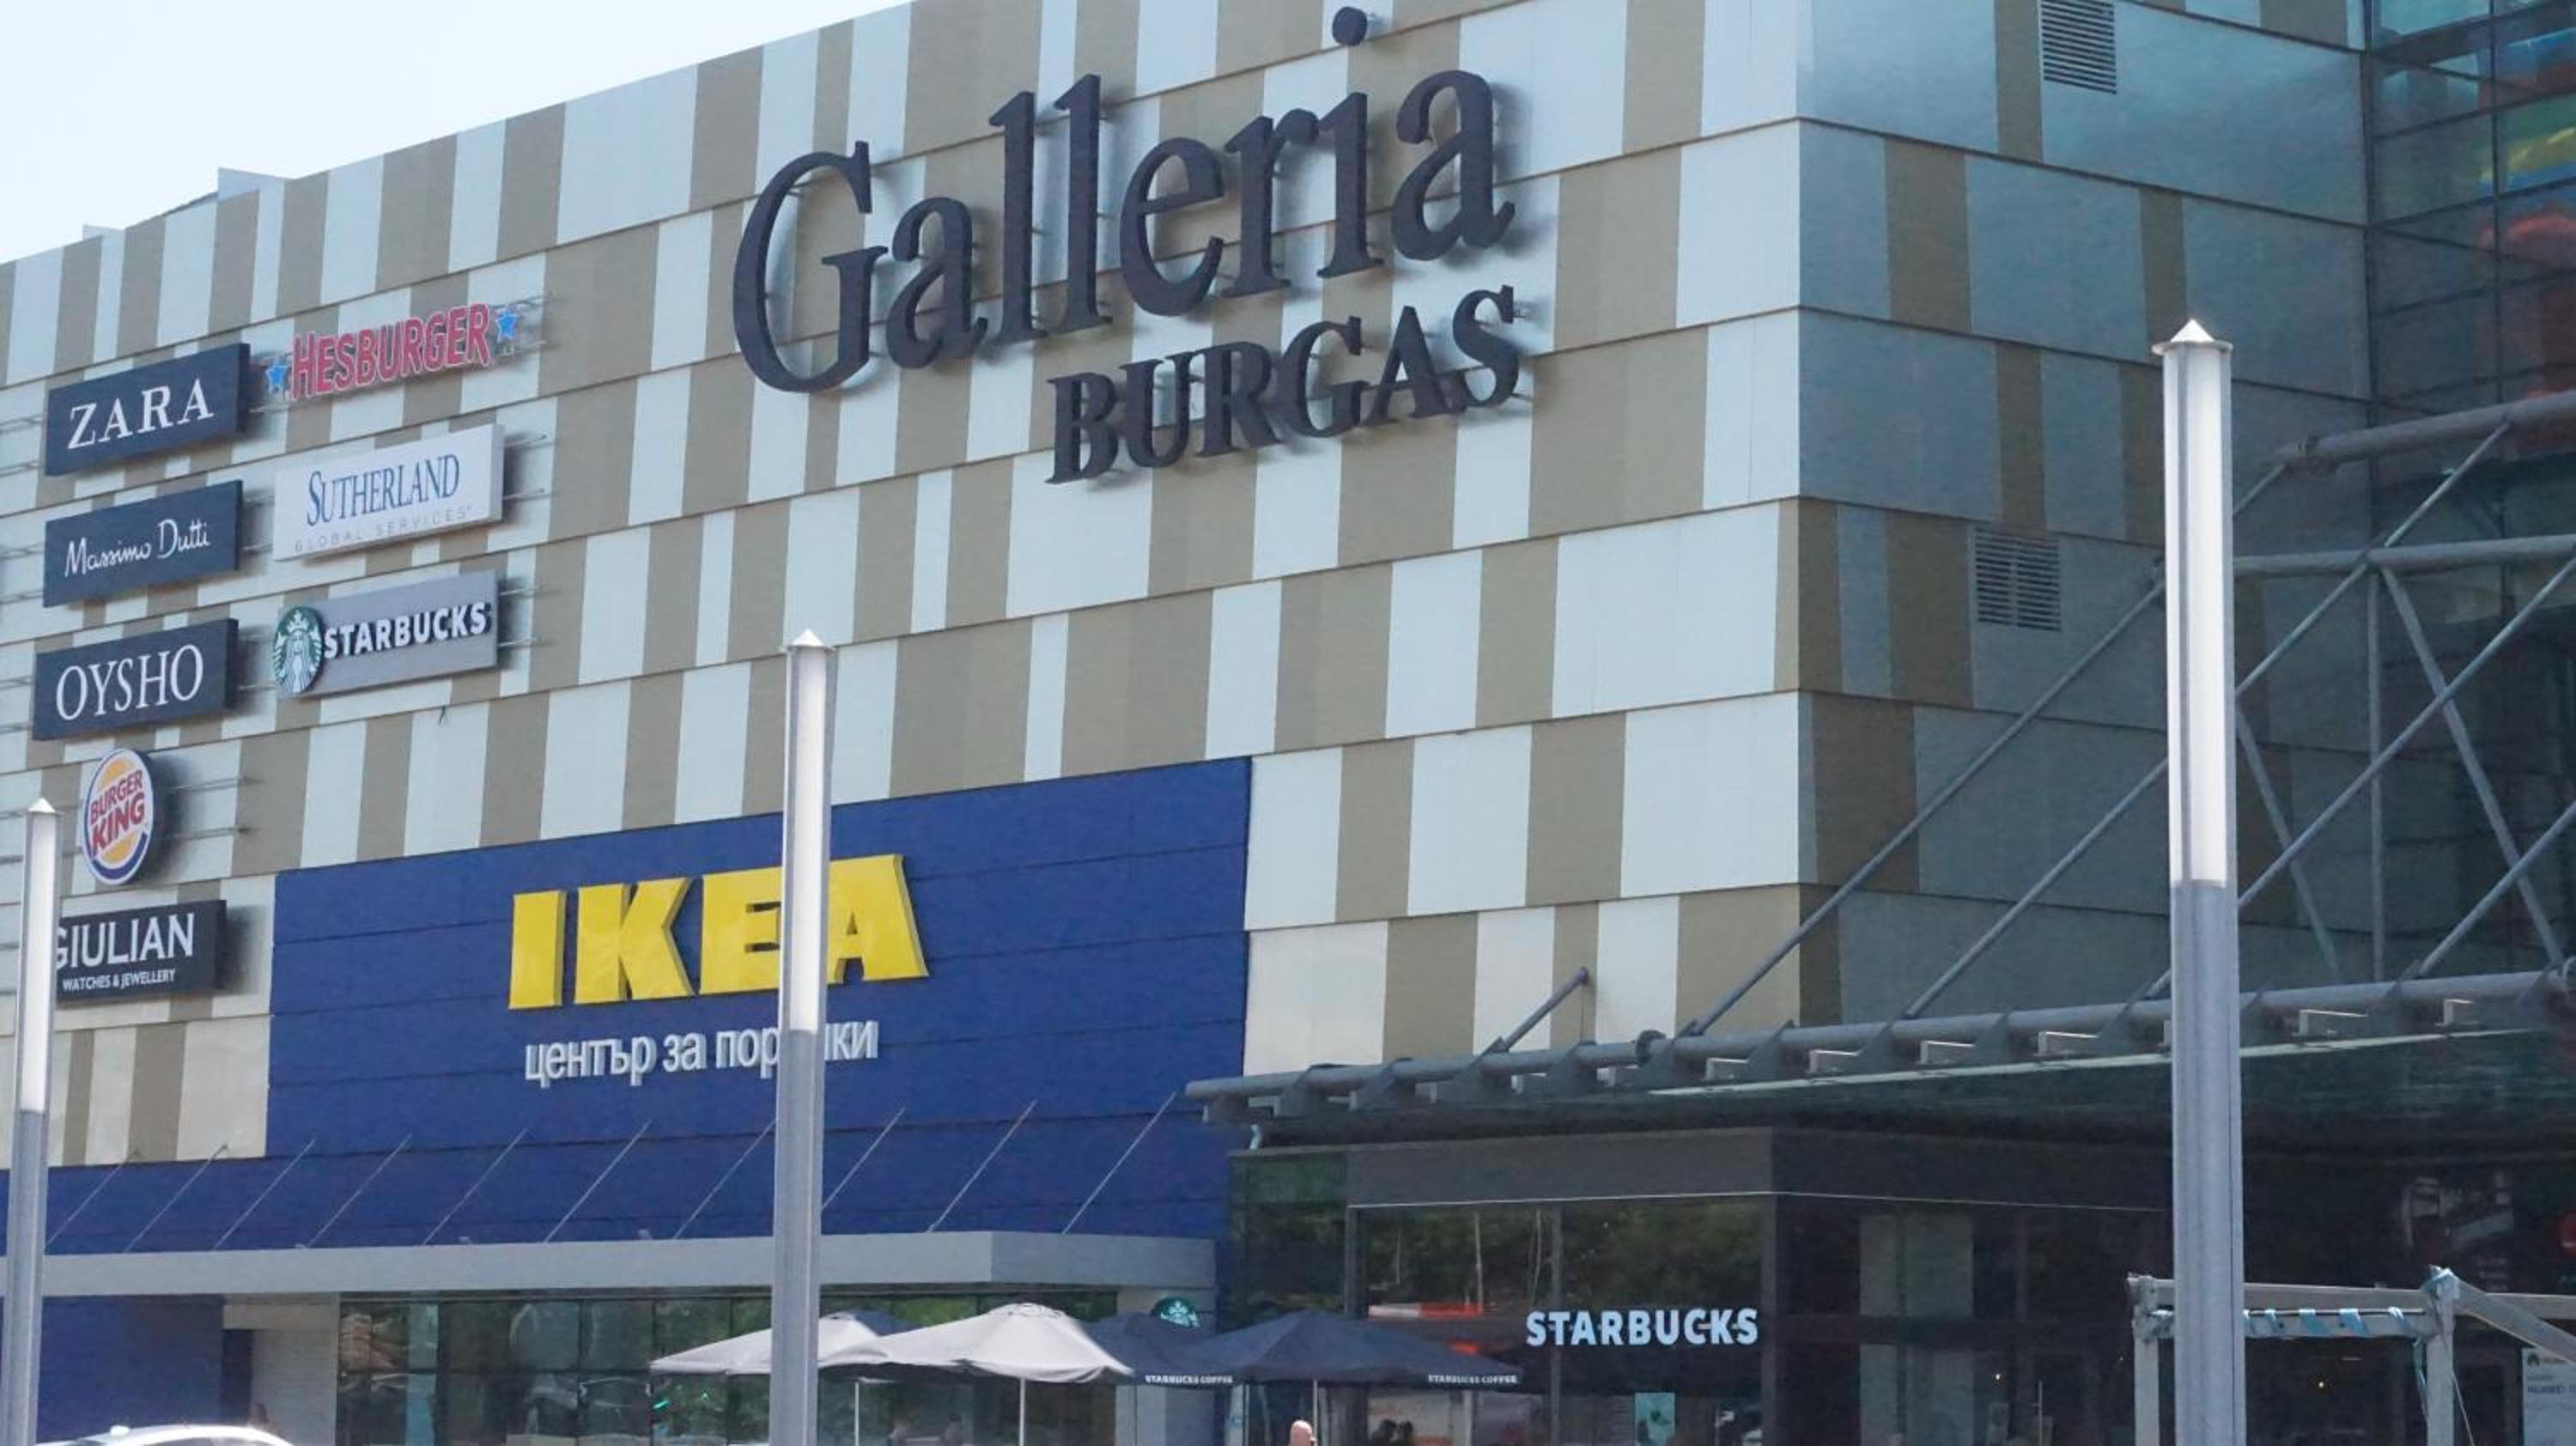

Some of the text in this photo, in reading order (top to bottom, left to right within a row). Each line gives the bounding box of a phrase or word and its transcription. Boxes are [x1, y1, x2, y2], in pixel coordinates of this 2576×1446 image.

[732, 6, 1517, 395] Galleria
[289, 301, 491, 400] HESBURGER
[1044, 284, 1521, 485] BURGAS
[68, 379, 214, 451] ZARA
[306, 453, 459, 527] SUTHERLAND
[64, 518, 211, 578] Massimo Dutti
[295, 506, 469, 552] GLOBAL SERVICES
[324, 602, 487, 659] STARBUCKS
[56, 644, 204, 721] OYSHO
[90, 769, 144, 819] BURGER
[91, 791, 146, 858] KING
[508, 854, 930, 1010] IKEA
[63, 969, 176, 992] WATCHES & JEWELLERY
[525, 1019, 879, 1088] център за порки
[1526, 1307, 1759, 1346] STARBUCKS
